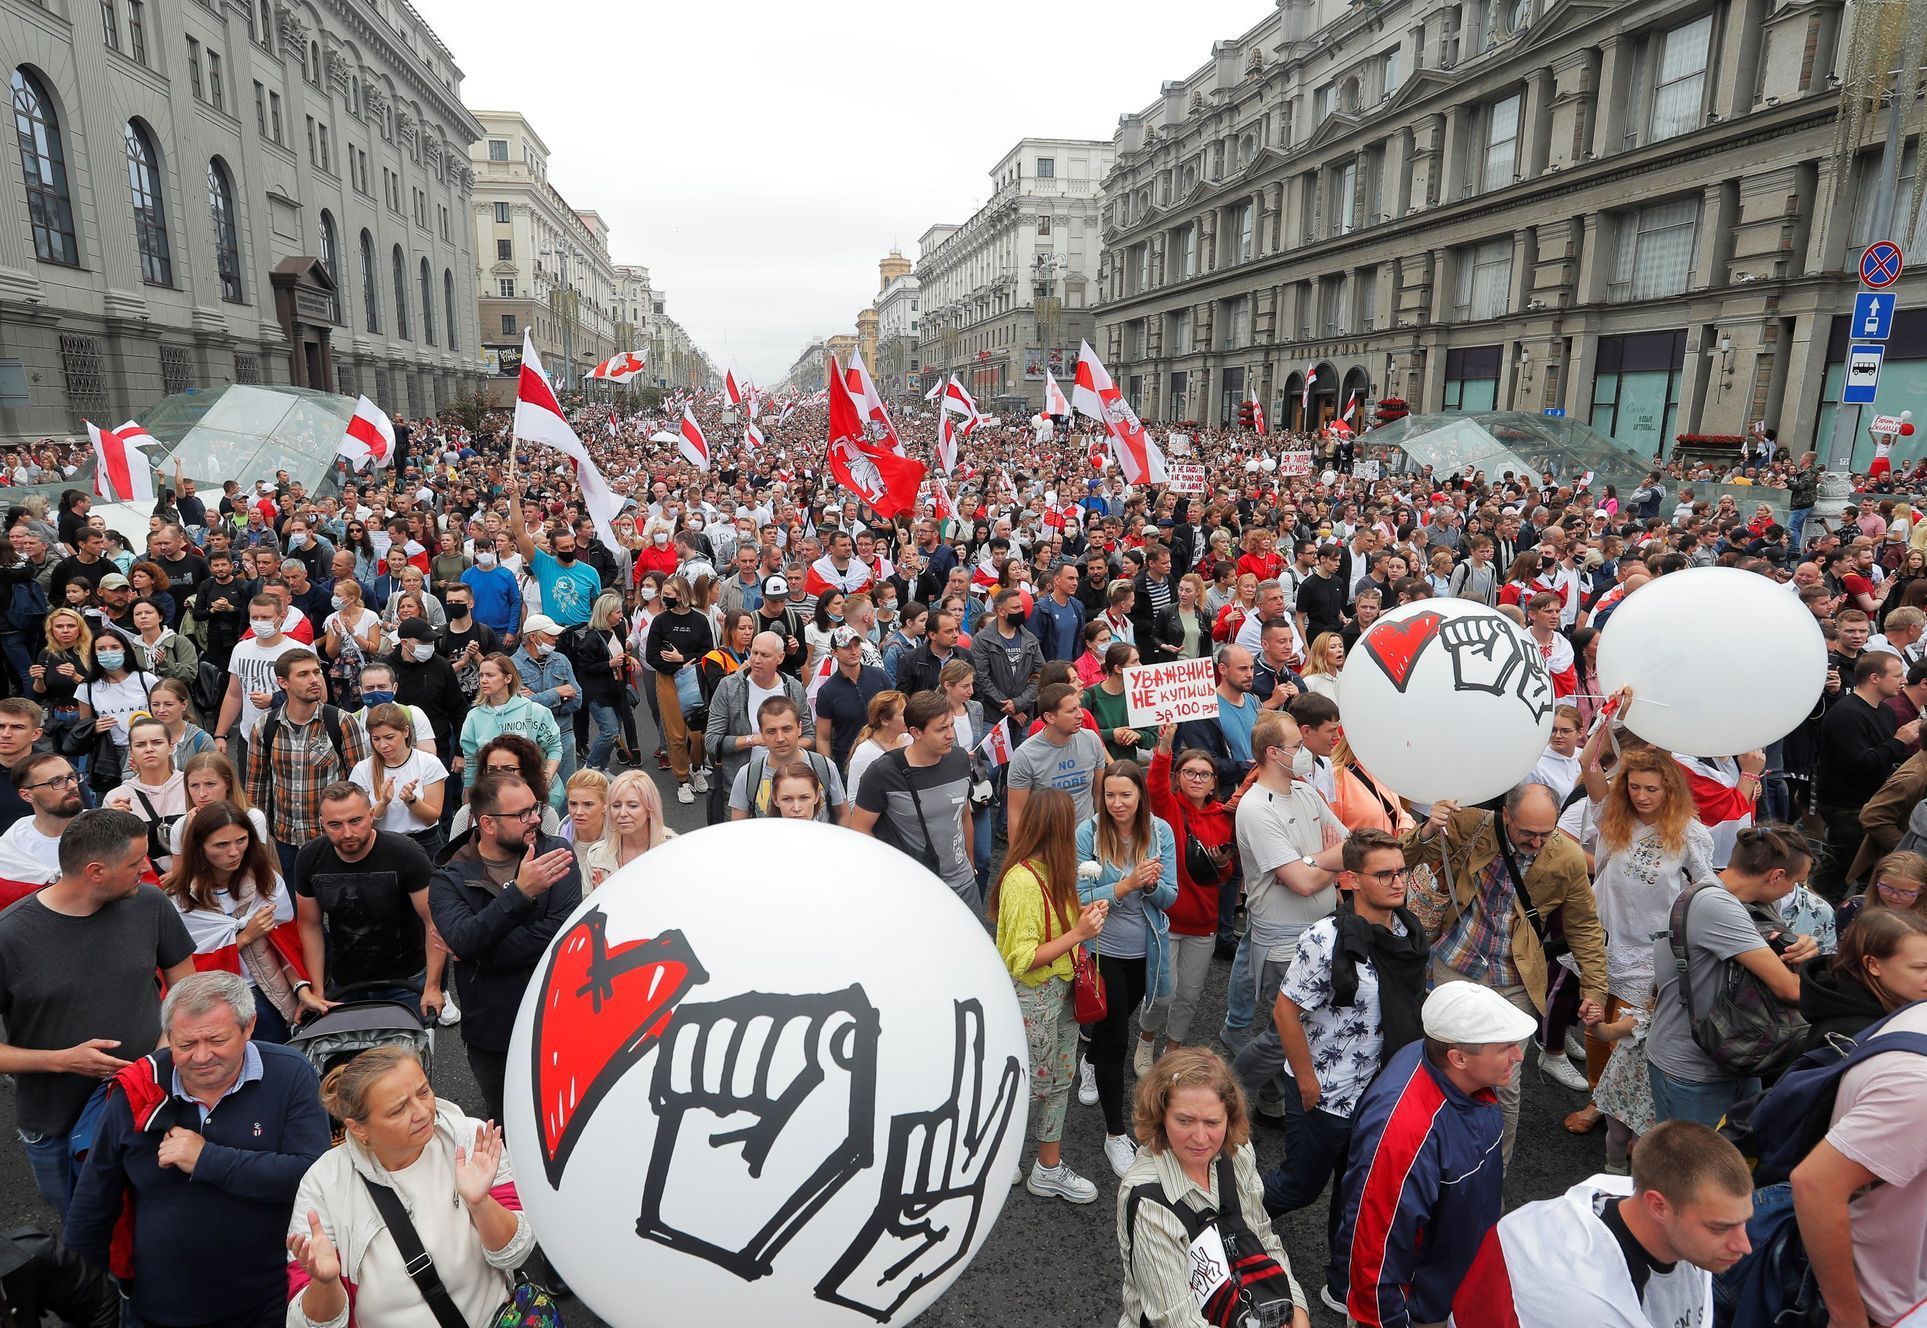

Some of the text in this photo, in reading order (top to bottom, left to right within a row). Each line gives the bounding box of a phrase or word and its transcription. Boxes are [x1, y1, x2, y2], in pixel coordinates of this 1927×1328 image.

[1129, 660, 1214, 689] УВАЖЕНИЕ
[1131, 682, 1215, 710] НЕ КУПИШЬ
[1155, 709, 1174, 722] ЗА
[1174, 701, 1200, 716] 100
[1059, 759, 1076, 770] NO
